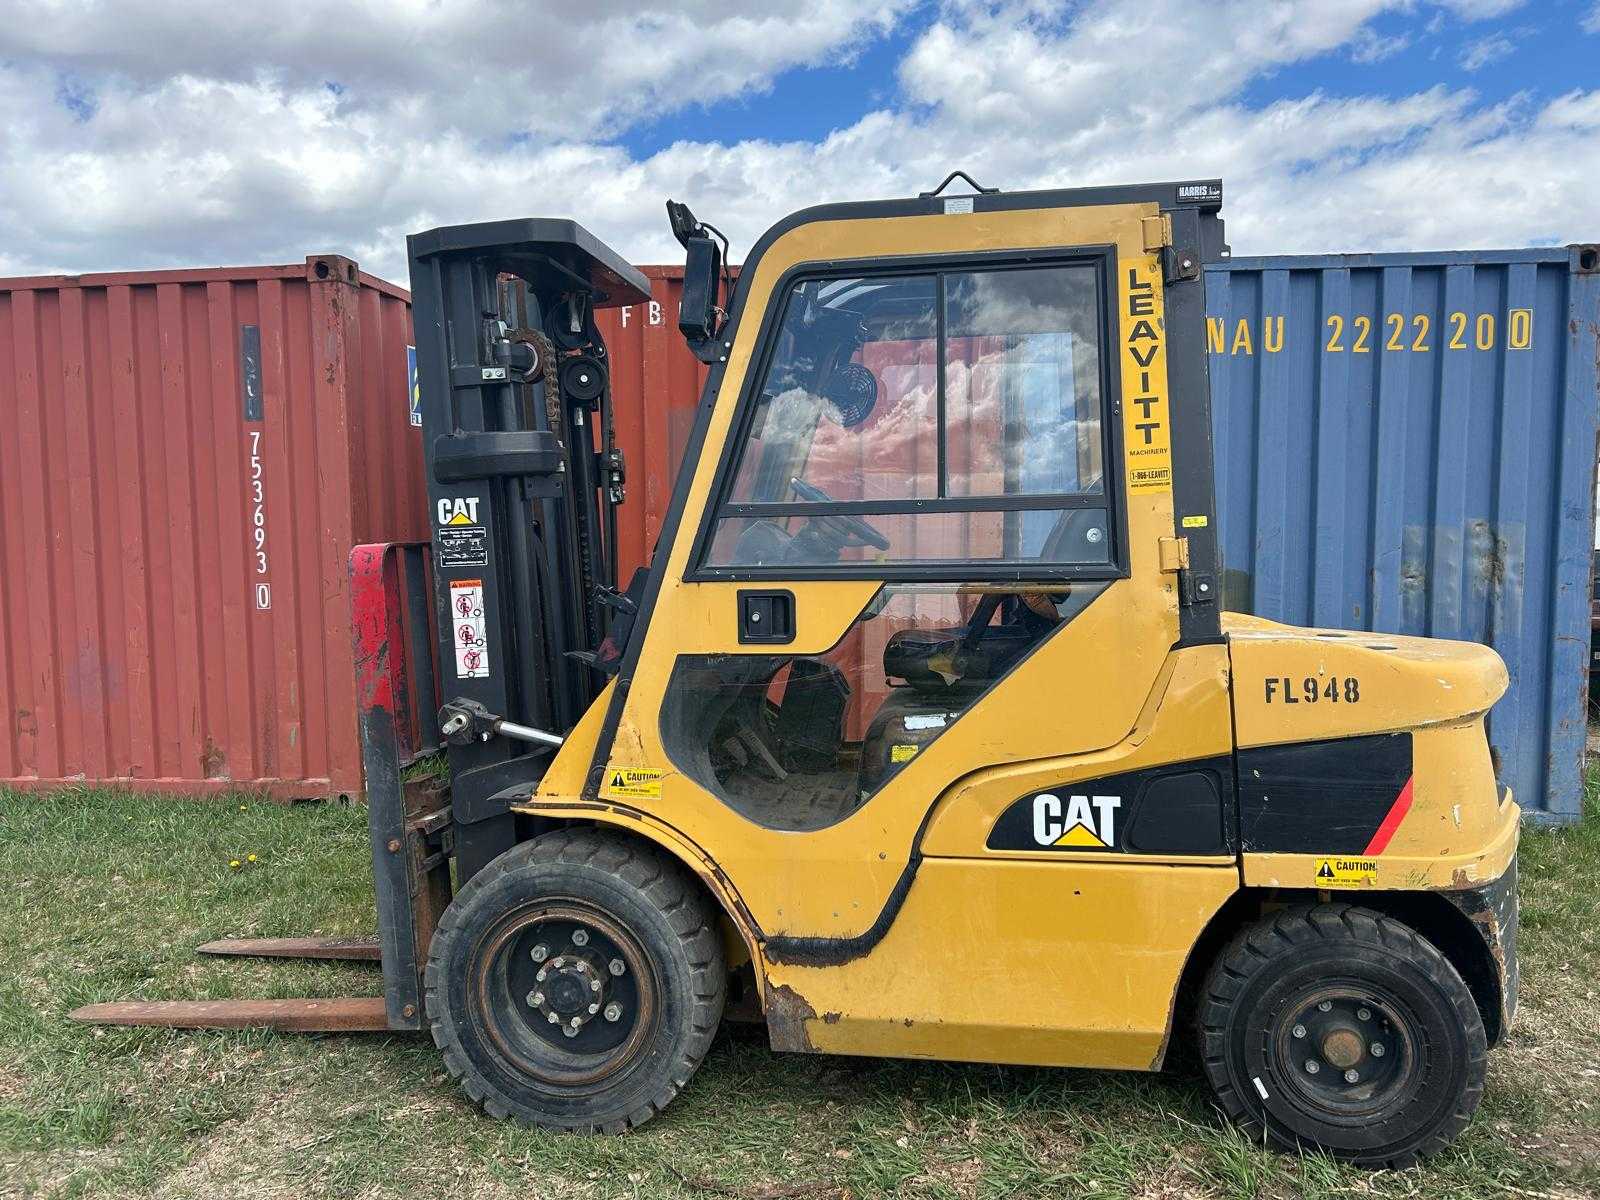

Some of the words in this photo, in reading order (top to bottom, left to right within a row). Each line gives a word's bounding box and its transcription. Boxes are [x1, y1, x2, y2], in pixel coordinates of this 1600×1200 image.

[1179, 185, 1207, 197] HARRIS
[1326, 311, 1495, 353] 222220
[1128, 268, 1161, 445] LEAVITT
[1129, 448, 1168, 456] MACHINERY
[250, 431, 267, 574] 753693
[437, 497, 480, 525] CAT
[1265, 677, 1360, 703] FL948
[626, 772, 660, 782] CAUTION
[1033, 793, 1121, 848] CAT
[1336, 861, 1376, 871] CAUTION
